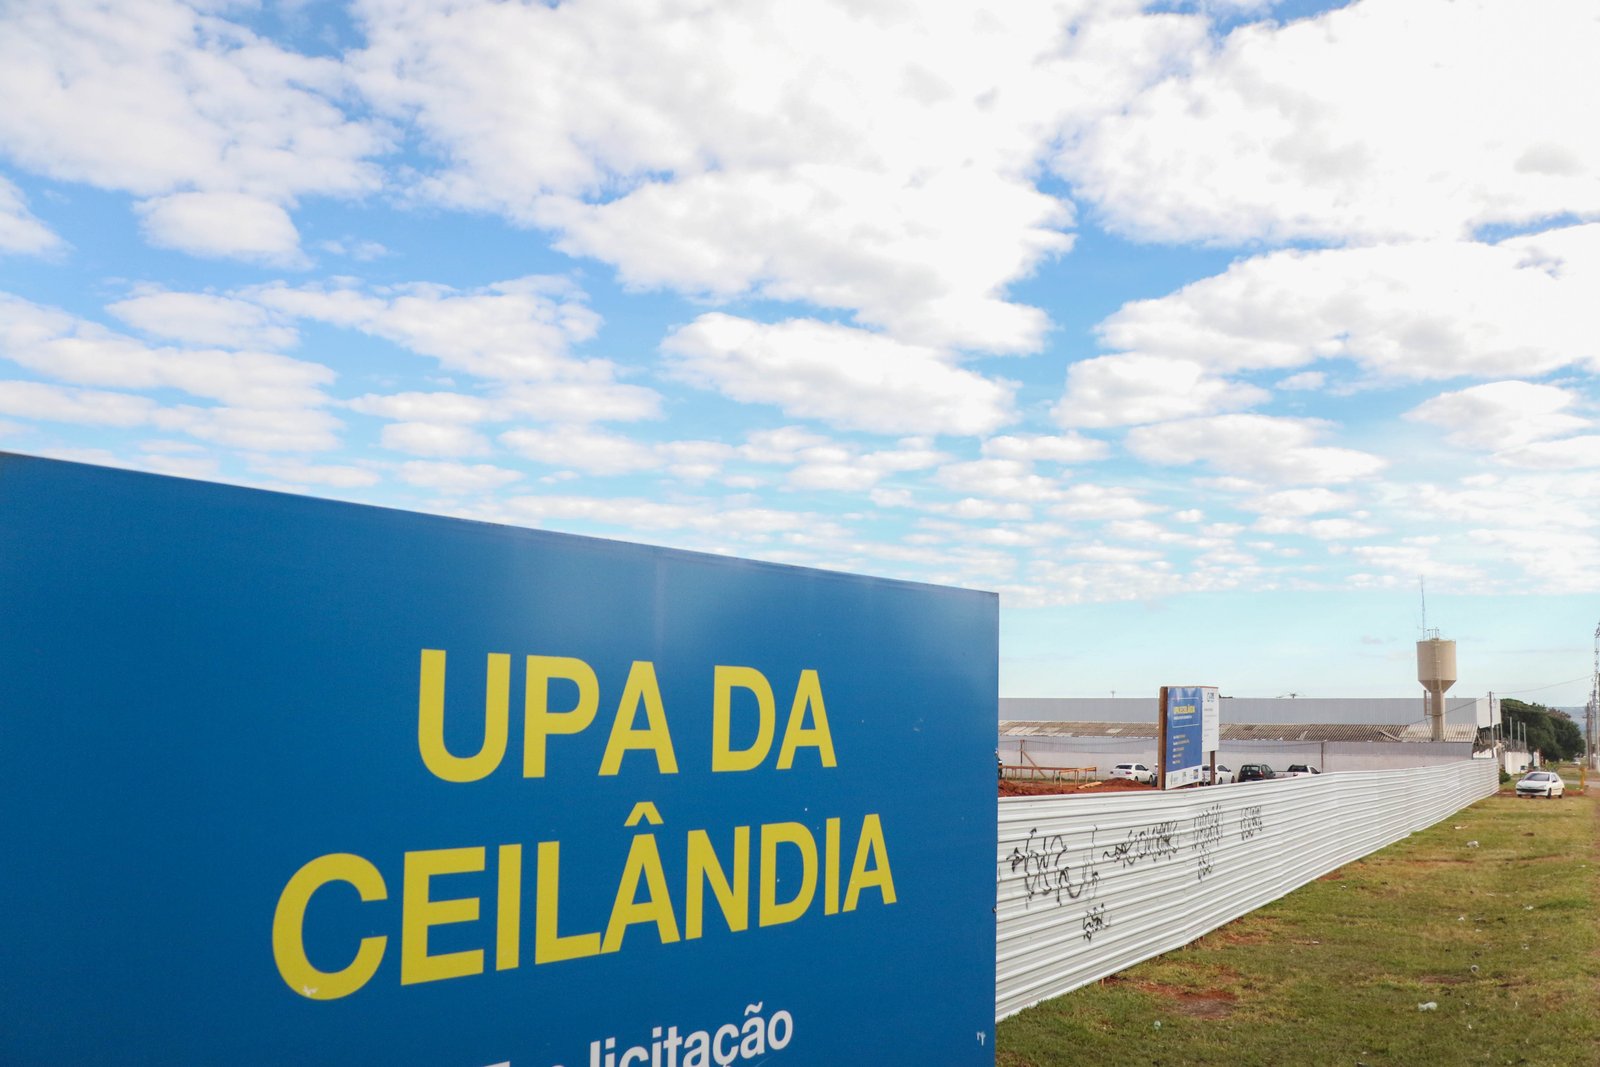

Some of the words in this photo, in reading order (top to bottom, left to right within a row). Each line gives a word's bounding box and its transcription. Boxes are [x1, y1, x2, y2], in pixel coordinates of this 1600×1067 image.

[418, 648, 679, 783] UPA
[711, 664, 837, 773] DA
[271, 801, 897, 1000] CEILÂNDIA
